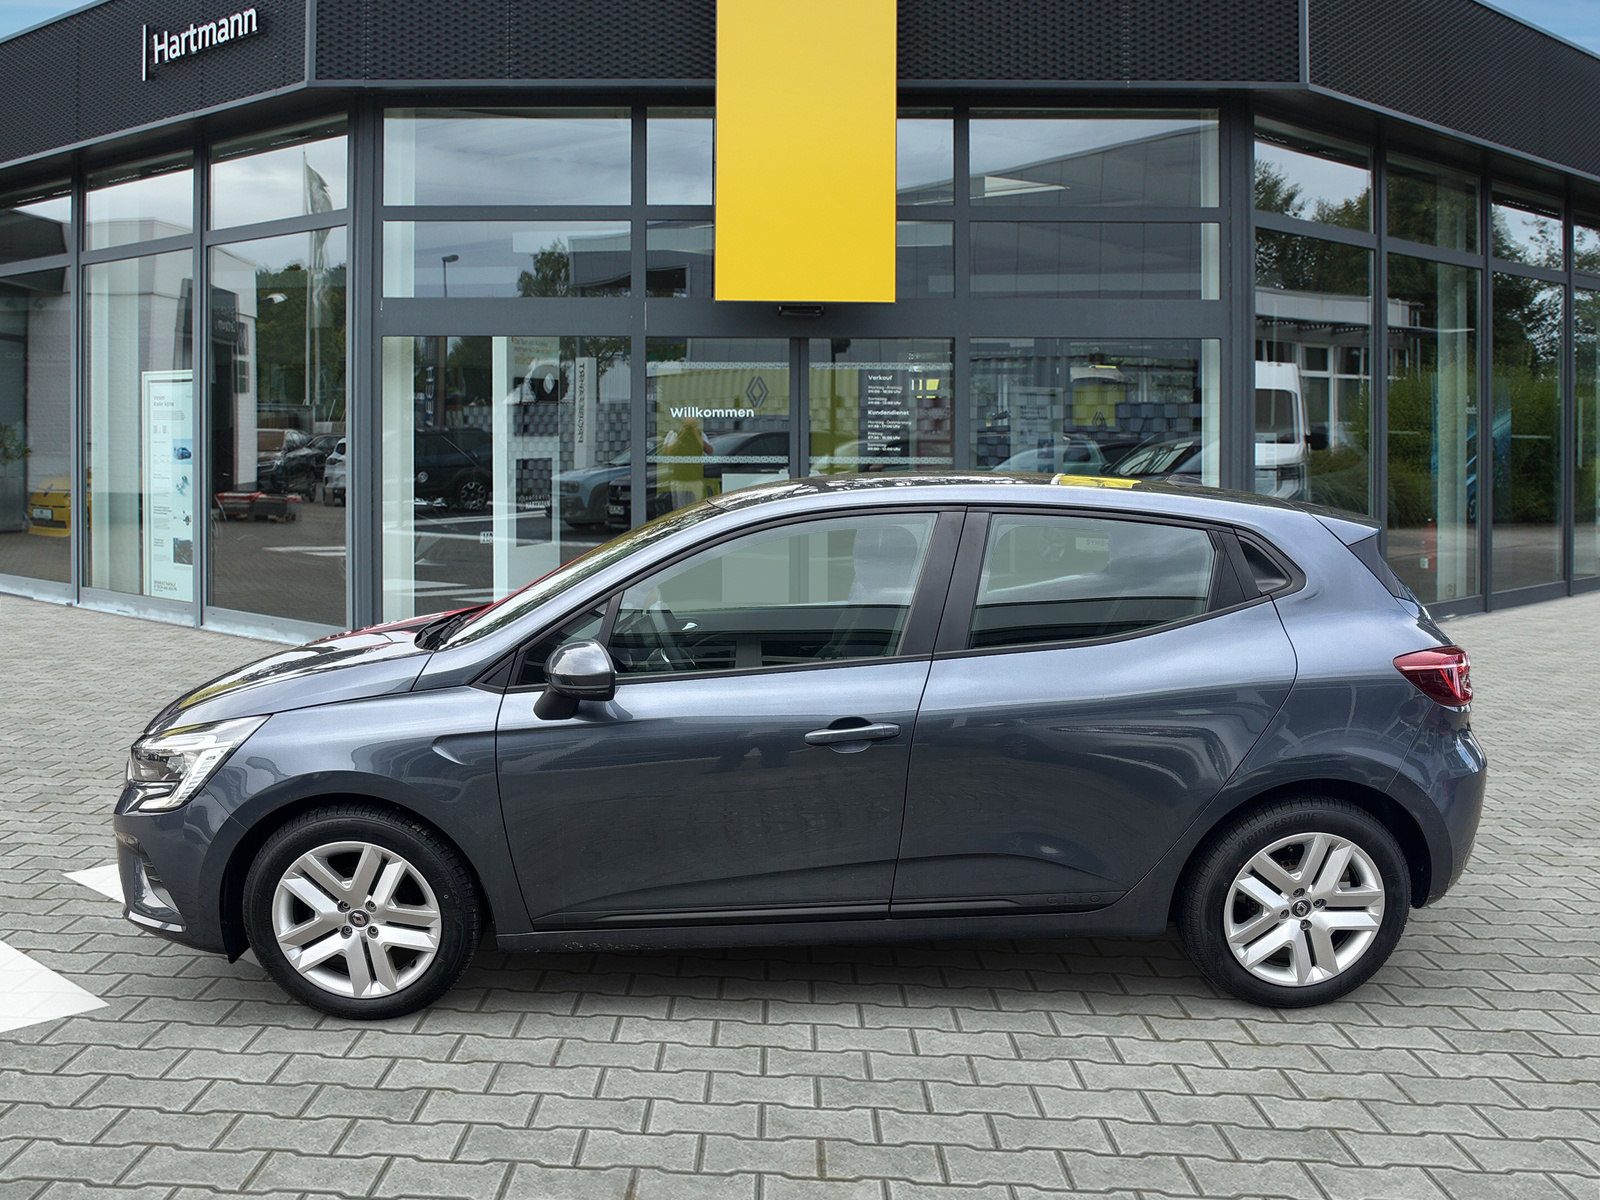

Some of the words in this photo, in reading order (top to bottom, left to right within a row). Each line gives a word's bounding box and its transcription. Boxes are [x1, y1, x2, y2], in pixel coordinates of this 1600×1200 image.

[153, 8, 258, 64] Hartmann
[670, 407, 755, 418] Willkommen
[1046, 894, 1101, 905] CLIO
